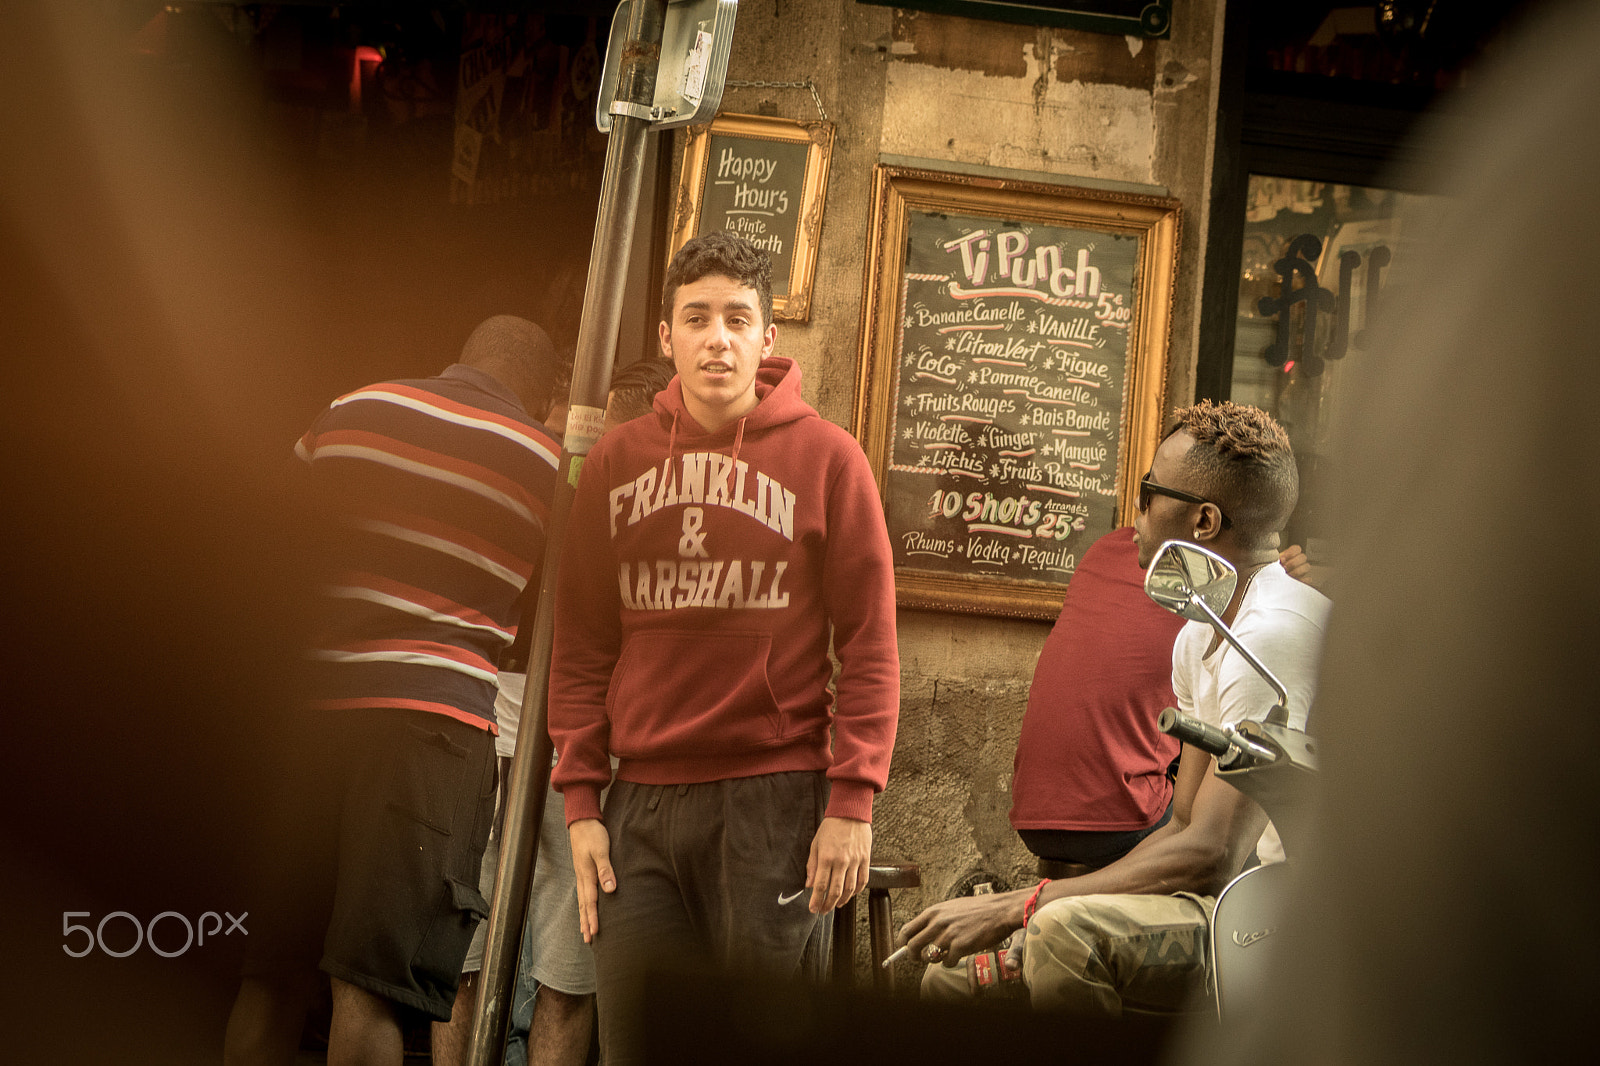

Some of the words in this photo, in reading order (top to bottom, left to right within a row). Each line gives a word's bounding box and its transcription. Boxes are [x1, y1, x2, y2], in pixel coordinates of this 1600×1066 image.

[718, 147, 777, 183] Happy
[734, 182, 789, 214] Hours
[725, 217, 735, 230] la
[737, 217, 767, 234] Pinte
[731, 231, 783, 254] forth
[944, 229, 991, 286] Ti
[997, 231, 1101, 298] Punch
[1055, 349, 1110, 378] Figue
[917, 393, 960, 412] Fruits
[962, 393, 1016, 417] Rouges
[916, 421, 972, 444] Violette
[989, 427, 1038, 450] Ginger
[1054, 438, 1107, 464] Mangue
[931, 450, 985, 472] Litchis
[999, 458, 1043, 482] Fruits
[1044, 461, 1101, 492] Passion
[609, 452, 796, 542] FRANKLIN
[928, 489, 963, 519] 10
[963, 491, 1042, 526] Shots
[678, 507, 710, 558] &
[902, 531, 954, 554] Rhums
[967, 536, 1011, 564] Vodka
[1019, 544, 1075, 570] Tequila
